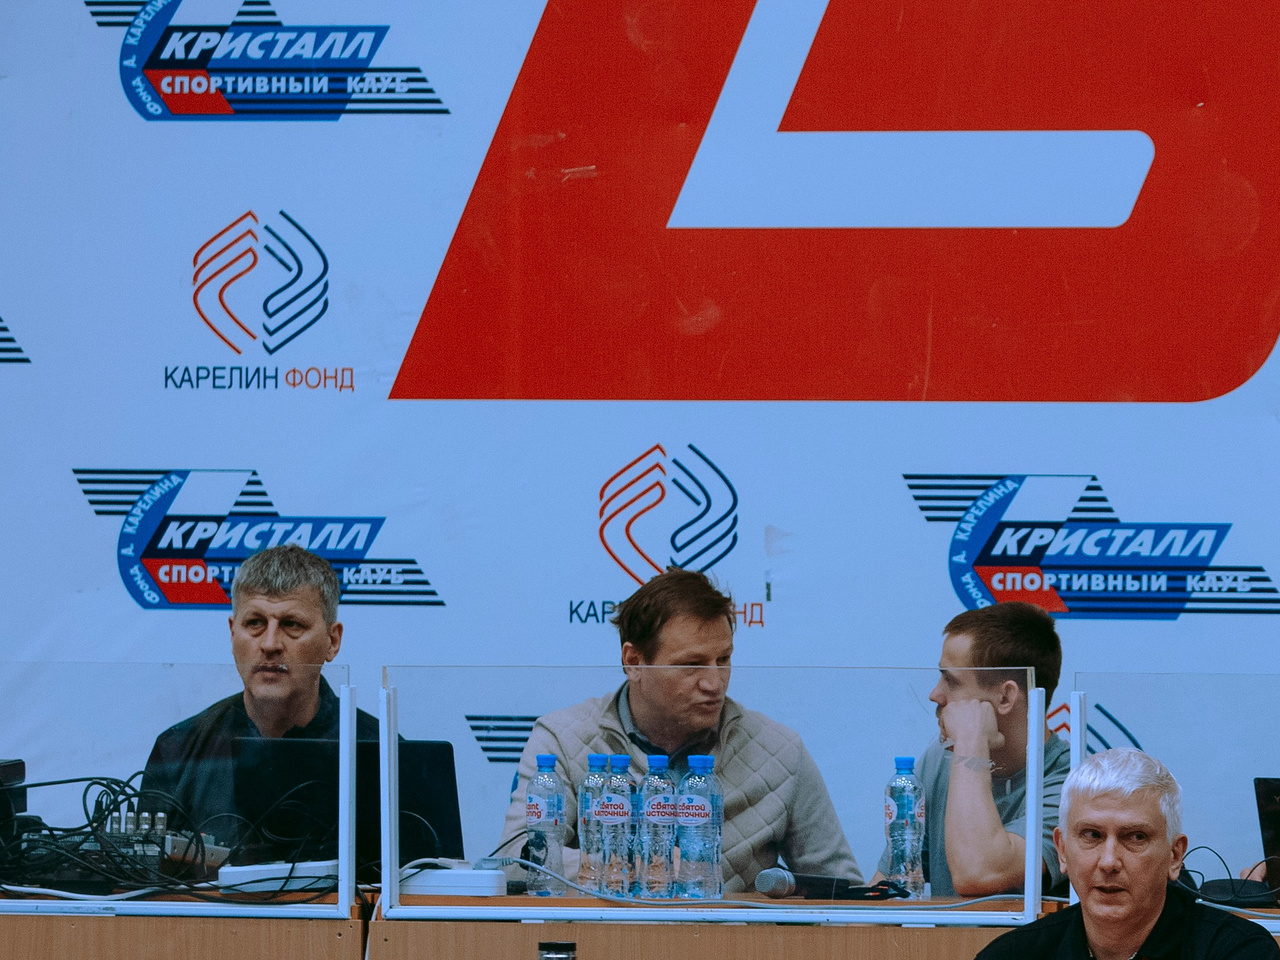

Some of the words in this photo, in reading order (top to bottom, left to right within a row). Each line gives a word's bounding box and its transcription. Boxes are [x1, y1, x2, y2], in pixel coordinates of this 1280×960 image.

[160, 32, 376, 60] КРИСТАЛЛ
[160, 74, 329, 94] СПОРТИВНЫЙ
[347, 75, 409, 94] КЛУБ
[165, 366, 279, 389] КАРЕЛИН
[285, 367, 355, 393] ФОНД
[157, 521, 372, 550] КРИСТАЛЛ
[990, 527, 1218, 556] КРИСТАЛЛ
[343, 566, 405, 585] КЛУБ
[991, 571, 1168, 592] СПОРТИВНЫЙ
[1187, 574, 1252, 593] КЛУБ
